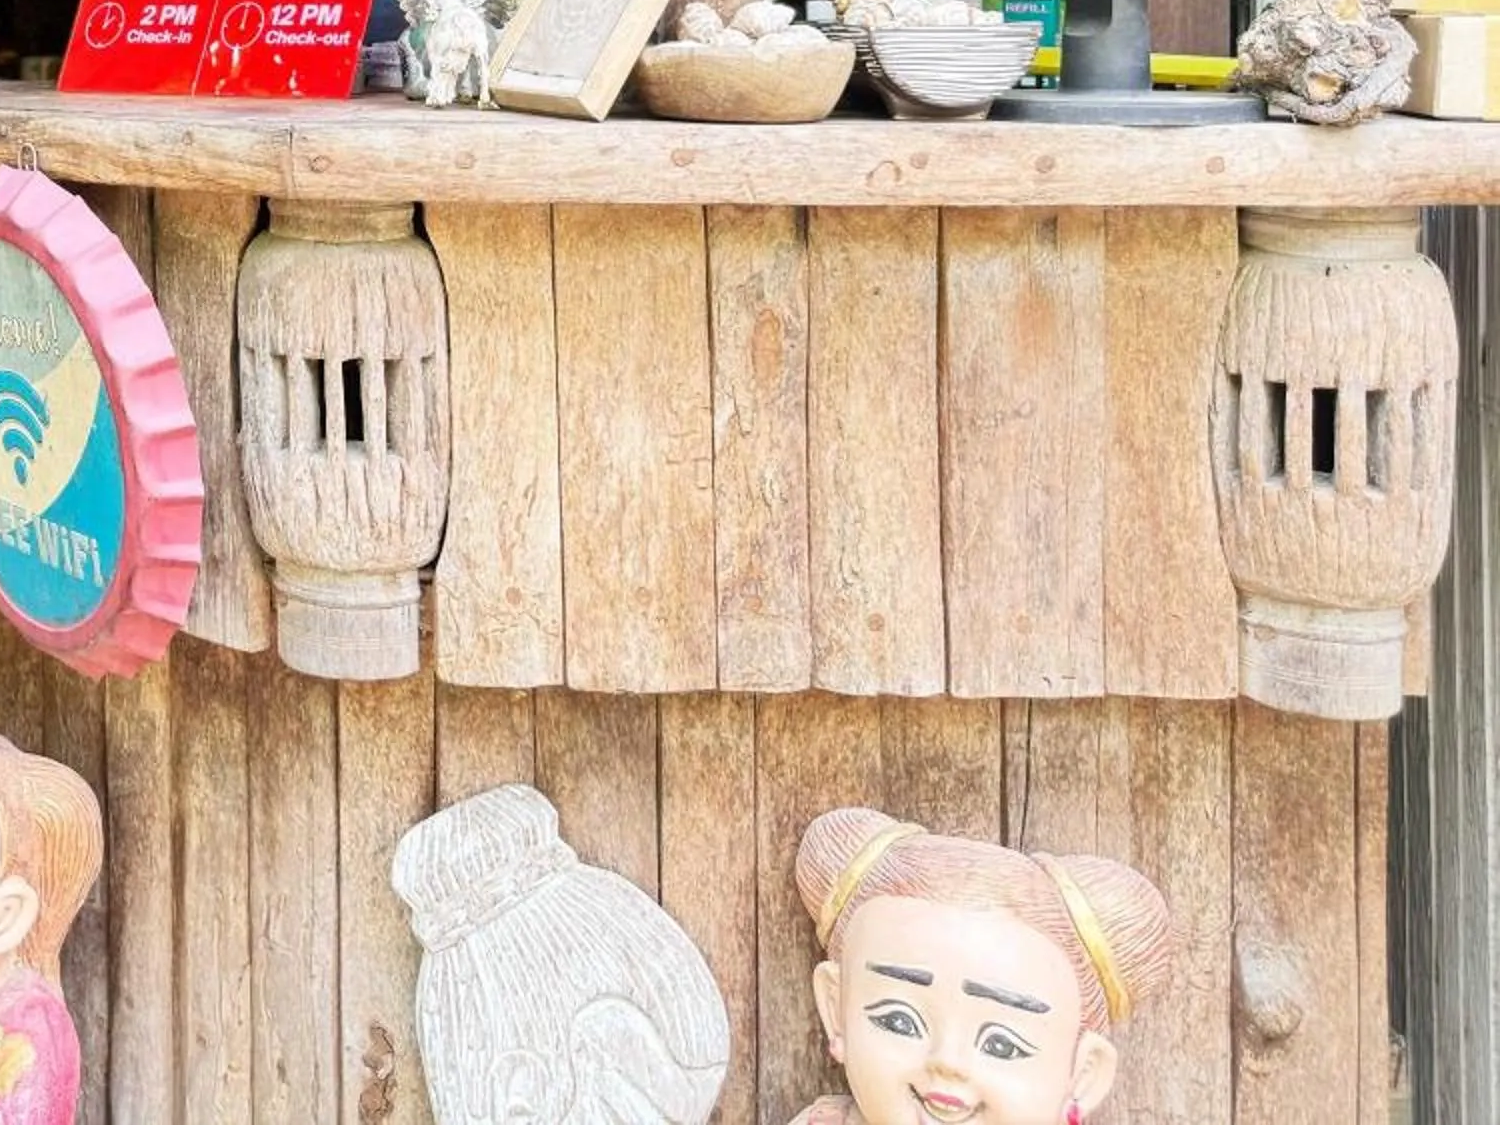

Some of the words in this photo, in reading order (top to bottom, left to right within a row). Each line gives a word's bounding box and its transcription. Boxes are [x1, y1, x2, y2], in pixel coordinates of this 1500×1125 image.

[270, 4, 297, 26] 12
[301, 4, 343, 26] PM
[1005, 2, 1048, 13] REFILL
[140, 5, 157, 25] 2
[159, 5, 197, 26] PM
[126, 29, 192, 44] Check-in
[264, 30, 351, 45] Check-out
